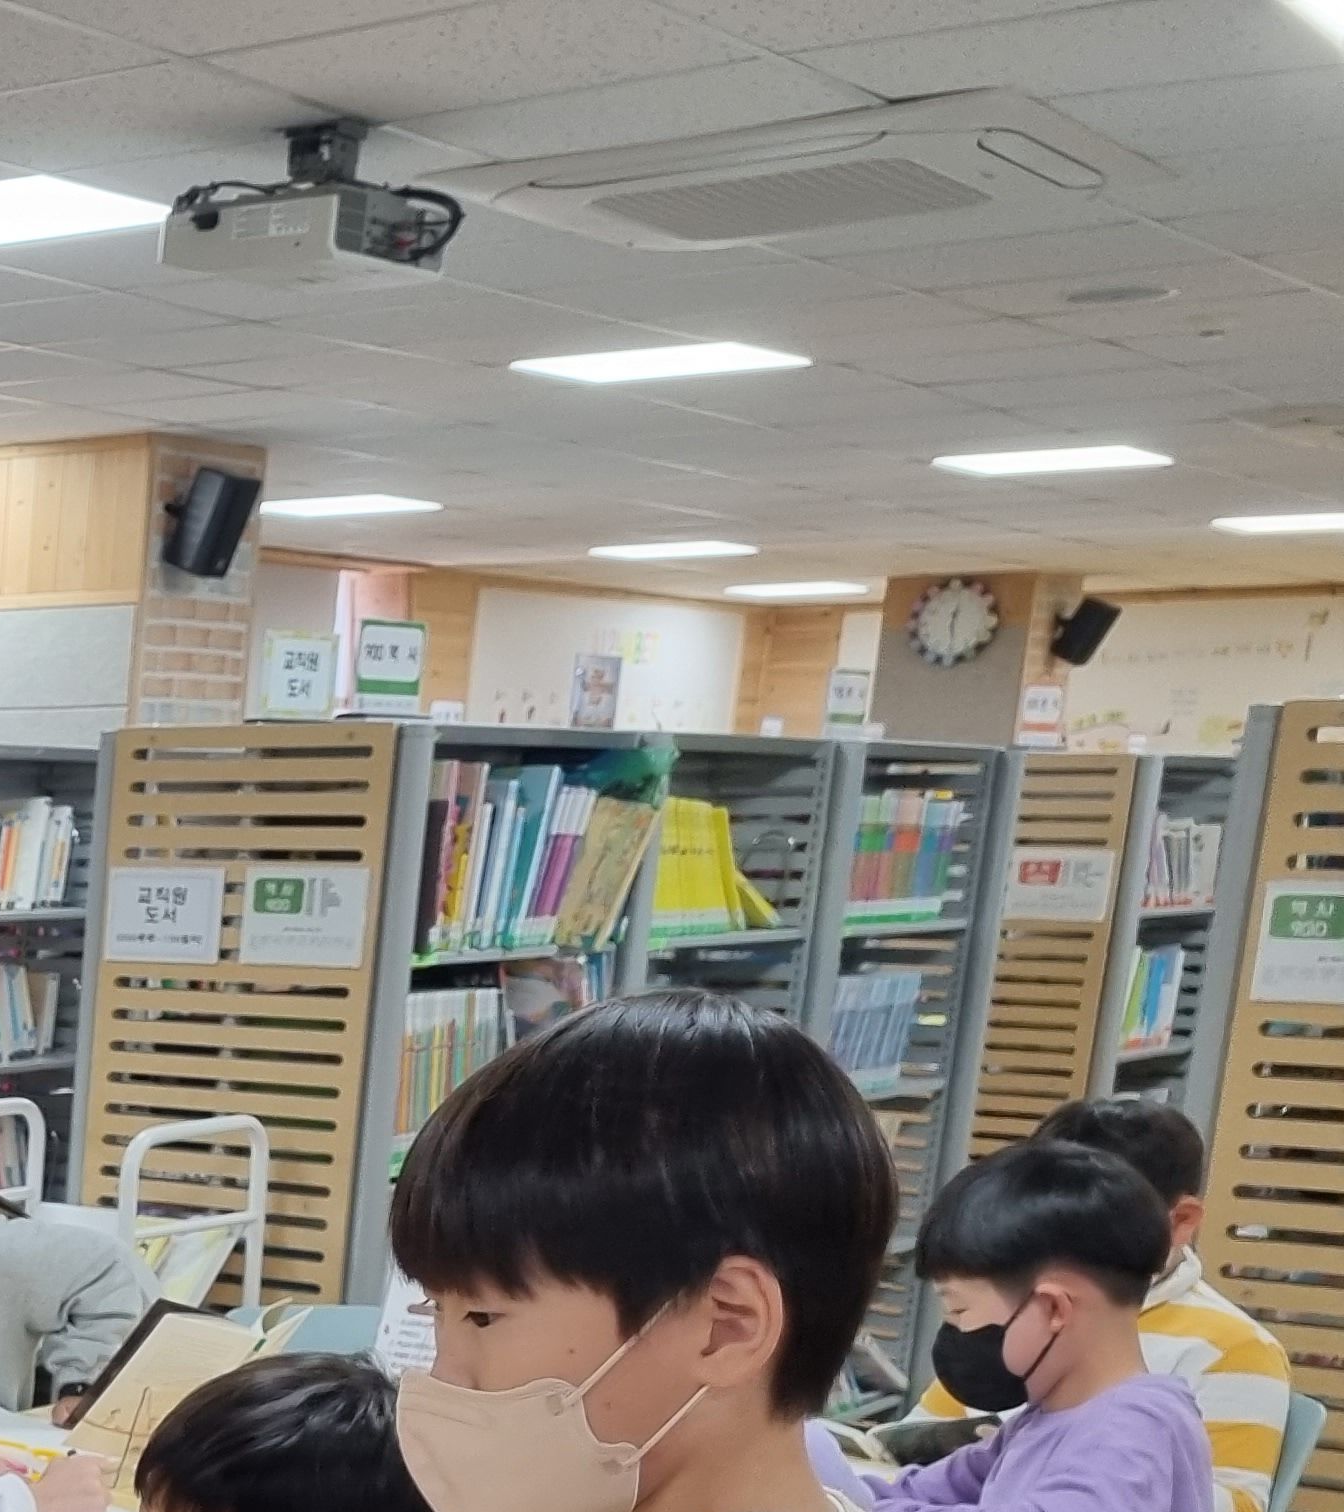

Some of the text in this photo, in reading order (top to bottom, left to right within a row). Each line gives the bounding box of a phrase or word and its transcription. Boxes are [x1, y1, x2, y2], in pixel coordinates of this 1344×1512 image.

[283, 652, 319, 672] 교직원
[287, 678, 310, 698] 도서
[138, 887, 188, 906] 교직원
[144, 906, 178, 924] 도서
